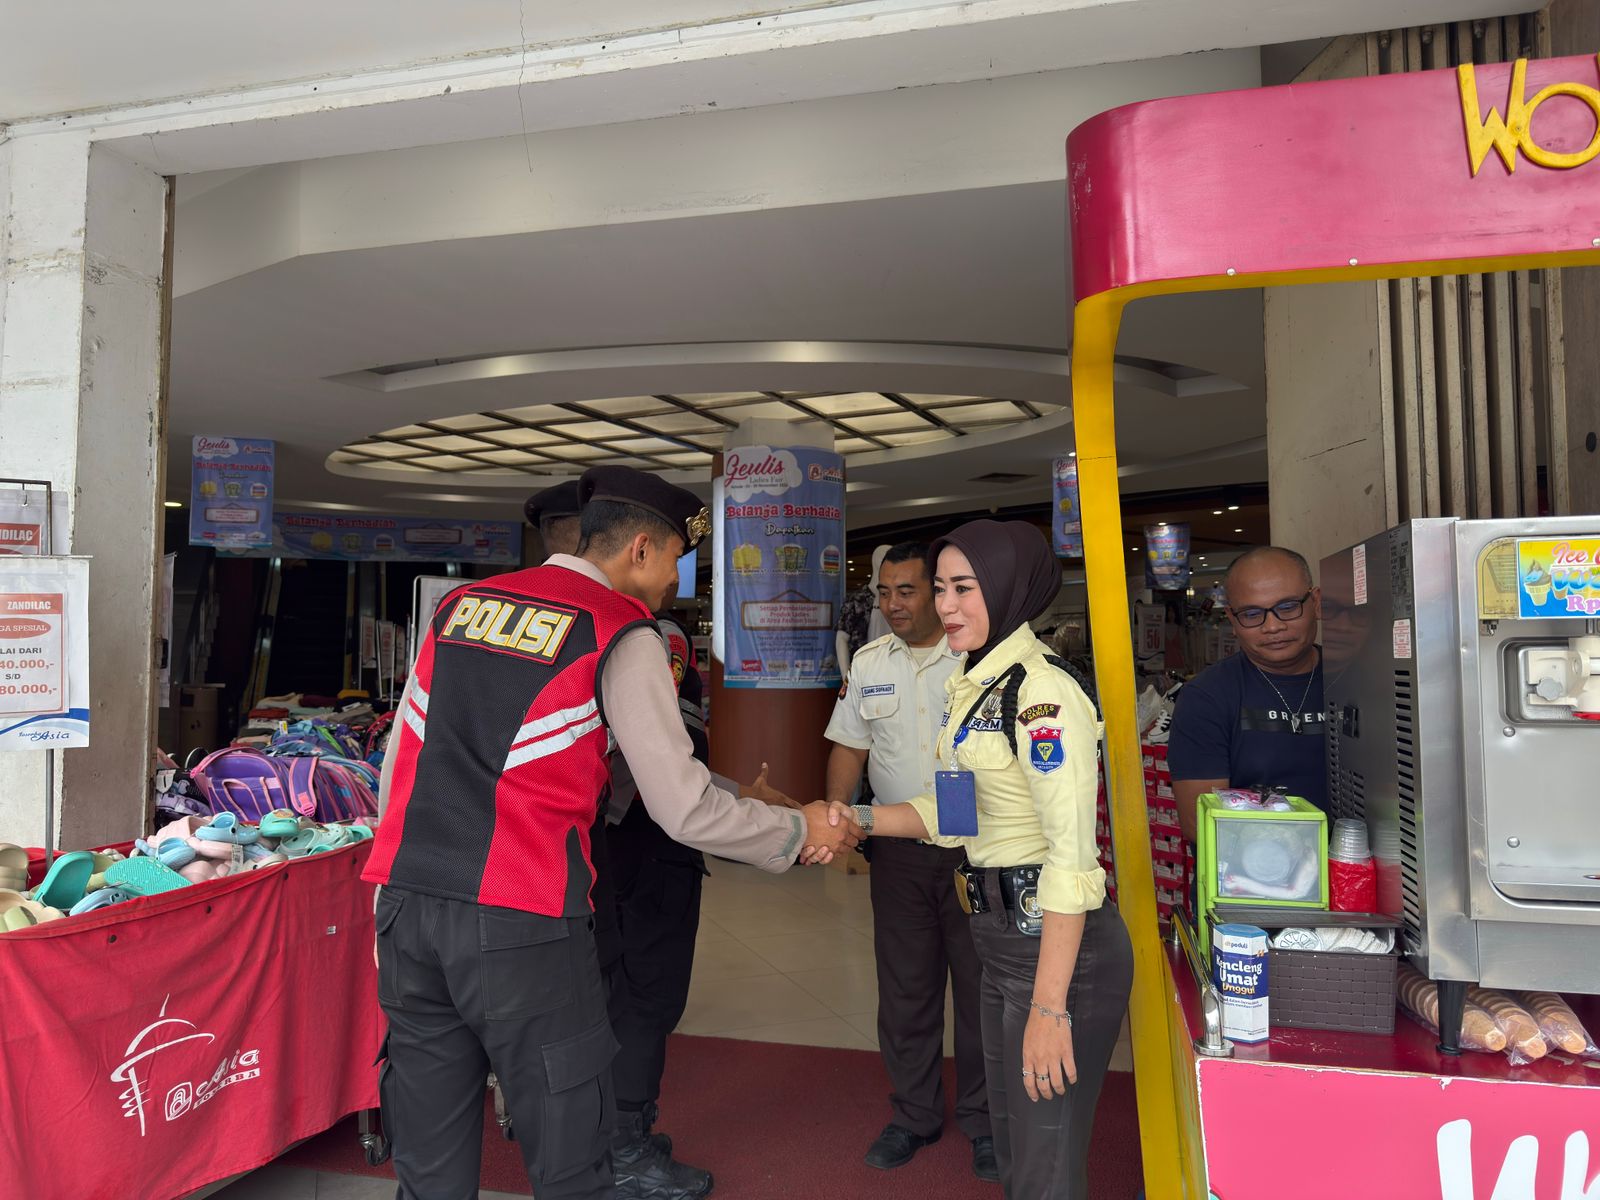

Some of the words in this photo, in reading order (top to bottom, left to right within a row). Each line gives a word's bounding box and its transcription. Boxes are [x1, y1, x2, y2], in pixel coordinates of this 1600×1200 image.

[724, 454, 785, 488] Geulis
[727, 506, 779, 519] Belanja
[0, 529, 33, 541] DILAC
[1552, 542, 1588, 565] Ice
[7, 601, 51, 610] ZANDILAC
[442, 597, 573, 658] POLISI
[1022, 705, 1055, 719] POLRES
[1268, 711, 1327, 722] GREN
[1220, 967, 1259, 986] Umat
[1222, 982, 1256, 995] Unggul
